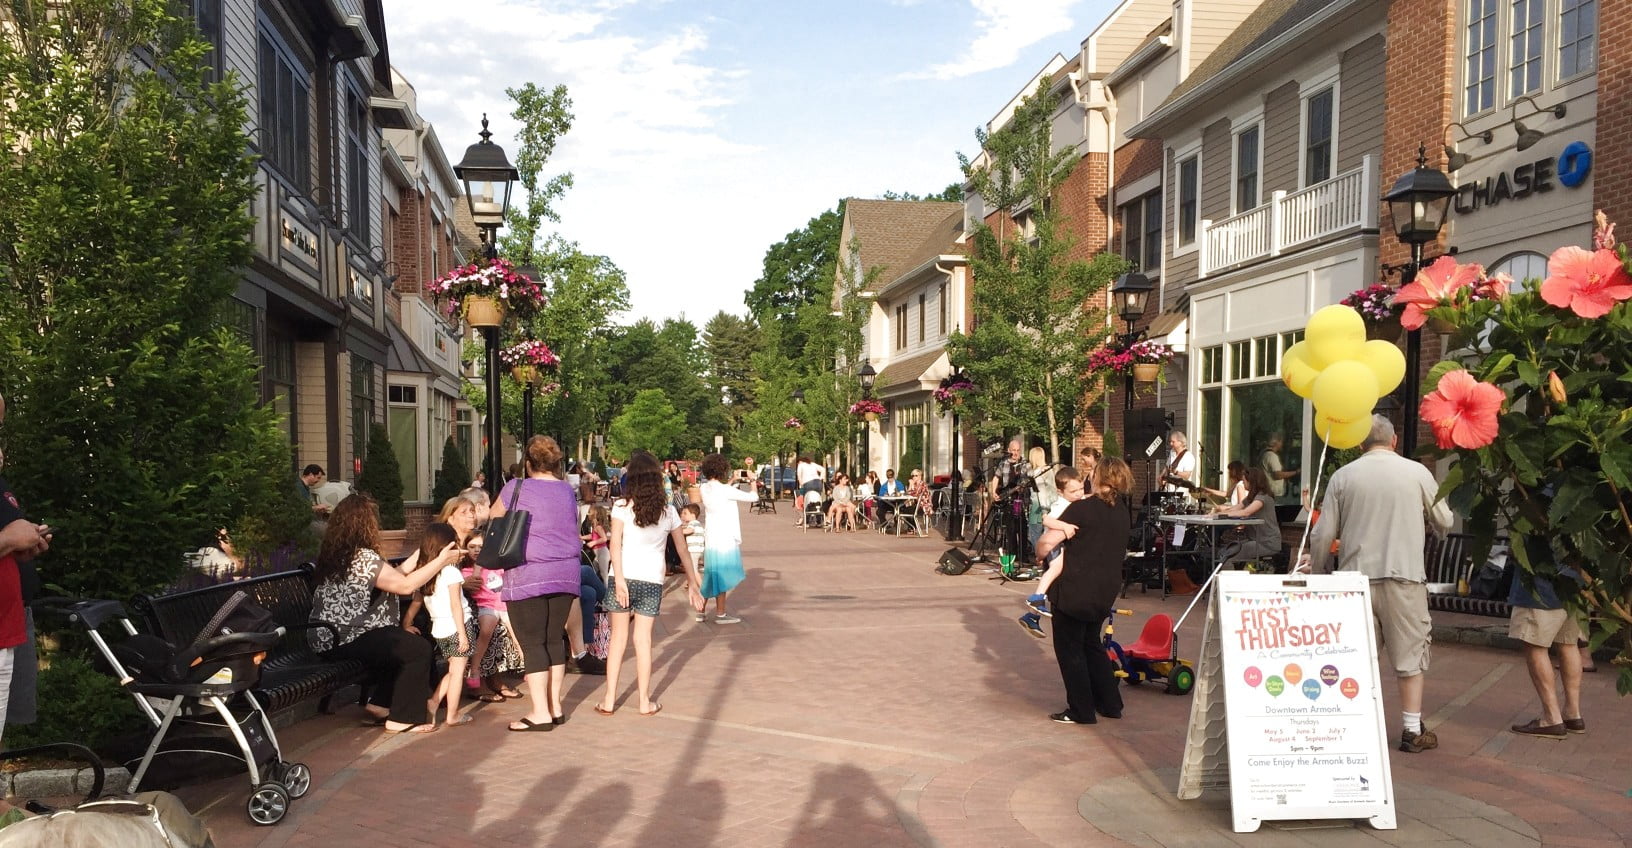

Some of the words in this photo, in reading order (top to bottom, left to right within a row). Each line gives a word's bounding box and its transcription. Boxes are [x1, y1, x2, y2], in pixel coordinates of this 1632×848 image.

[1454, 156, 1555, 214] CHASE
[1270, 649, 1313, 660] Community
[1315, 646, 1358, 656] Celebration
[1265, 705, 1308, 714] Downtown
[1310, 704, 1342, 713] Armonk
[1290, 718, 1320, 726] Thursdays
[1328, 727, 1341, 735] July
[1269, 736, 1291, 744] August
[1305, 735, 1337, 743] September
[1247, 758, 1271, 767] Come
[1273, 757, 1295, 768] Enjoy
[1297, 757, 1310, 766] the
[1312, 756, 1344, 766] Armonk
[1346, 756, 1369, 765] Buzz!
